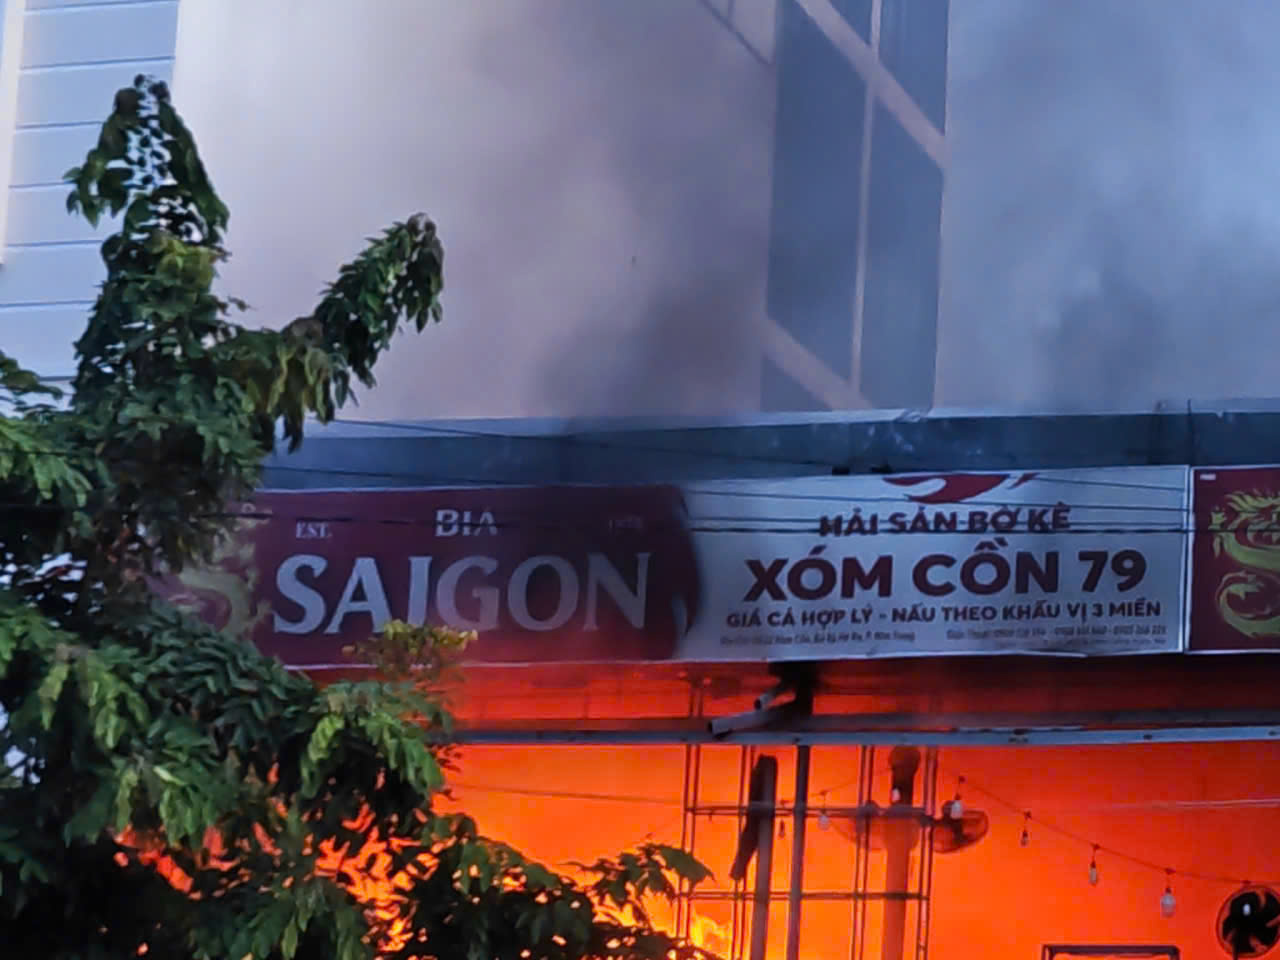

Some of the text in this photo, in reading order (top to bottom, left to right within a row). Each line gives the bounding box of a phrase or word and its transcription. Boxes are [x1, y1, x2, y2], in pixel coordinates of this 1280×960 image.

[295, 521, 332, 539] EST.
[434, 509, 498, 537] BIA
[819, 507, 878, 537] HẢI
[888, 506, 957, 534] SẢN
[968, 505, 1021, 533] BỜ
[742, 537, 1147, 602] XÓM CỒN 79
[273, 552, 652, 635] SAIGON
[726, 607, 761, 628] GIÁ
[767, 607, 795, 627] CẢ
[802, 608, 846, 631] HỢP
[892, 602, 935, 623] NẤU
[941, 605, 997, 622] THEO
[1067, 602, 1087, 623] VỊ
[1092, 602, 1104, 618] 3
[1109, 597, 1161, 618] MIỀN
